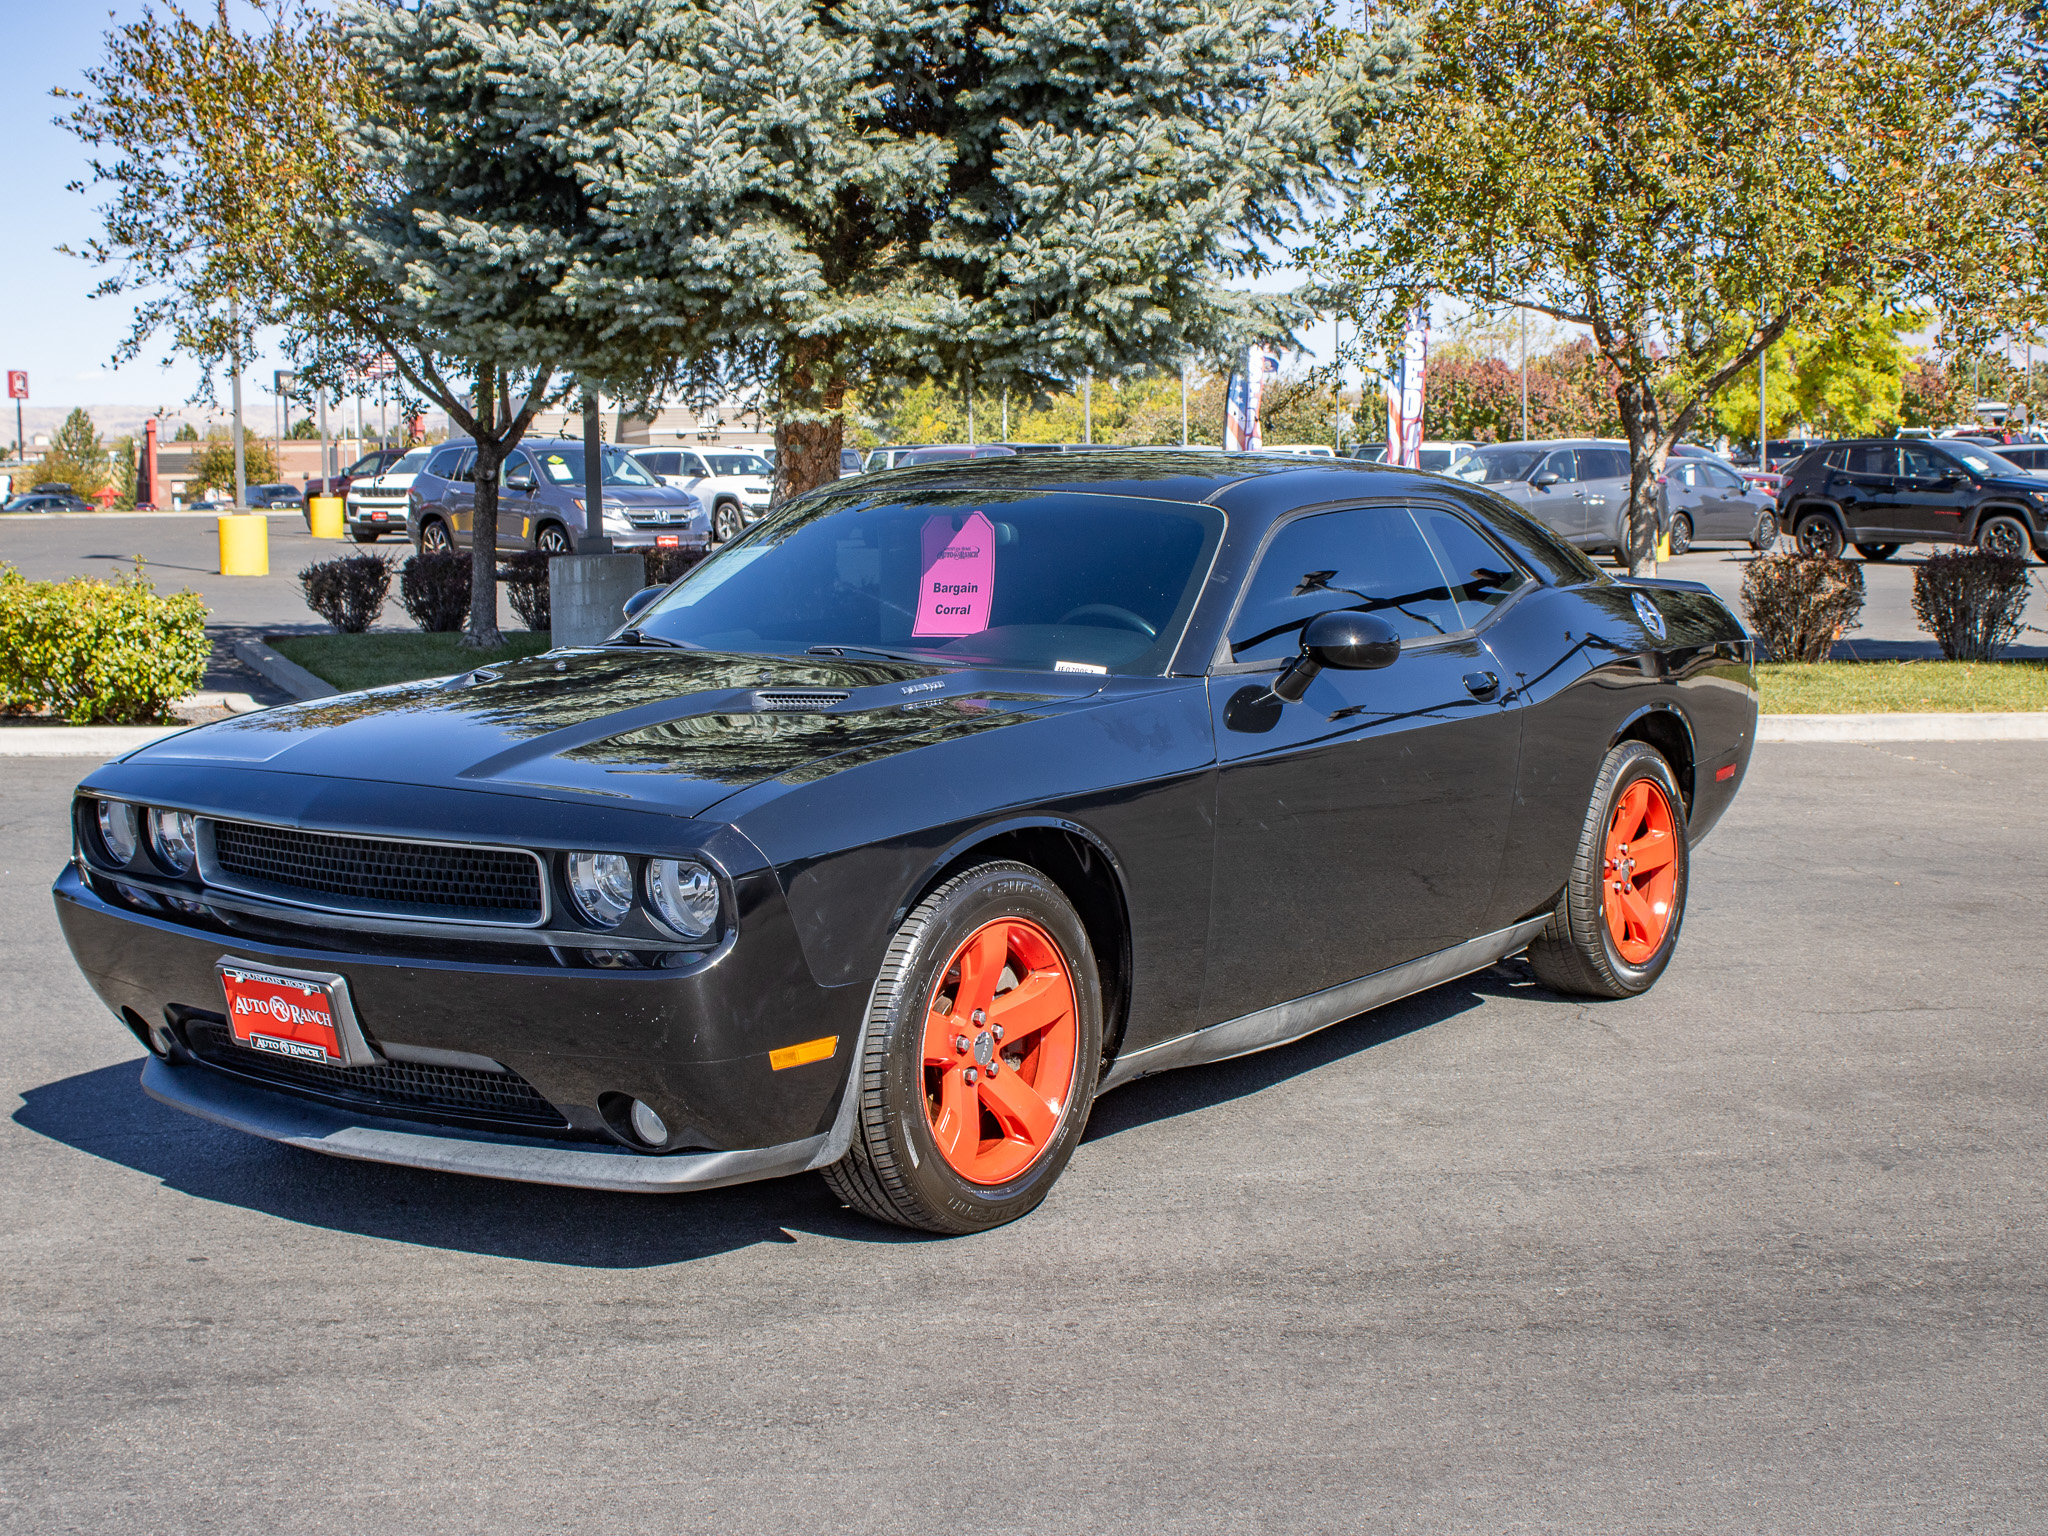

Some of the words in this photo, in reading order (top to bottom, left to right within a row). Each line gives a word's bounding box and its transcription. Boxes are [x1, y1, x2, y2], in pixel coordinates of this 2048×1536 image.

[933, 582, 978, 595] Bargain
[935, 604, 971, 615] Corral
[235, 996, 269, 1015] AUTO
[289, 1004, 333, 1027] RANCH
[256, 1037, 279, 1051] AUTO
[289, 1045, 320, 1059] RANCH
